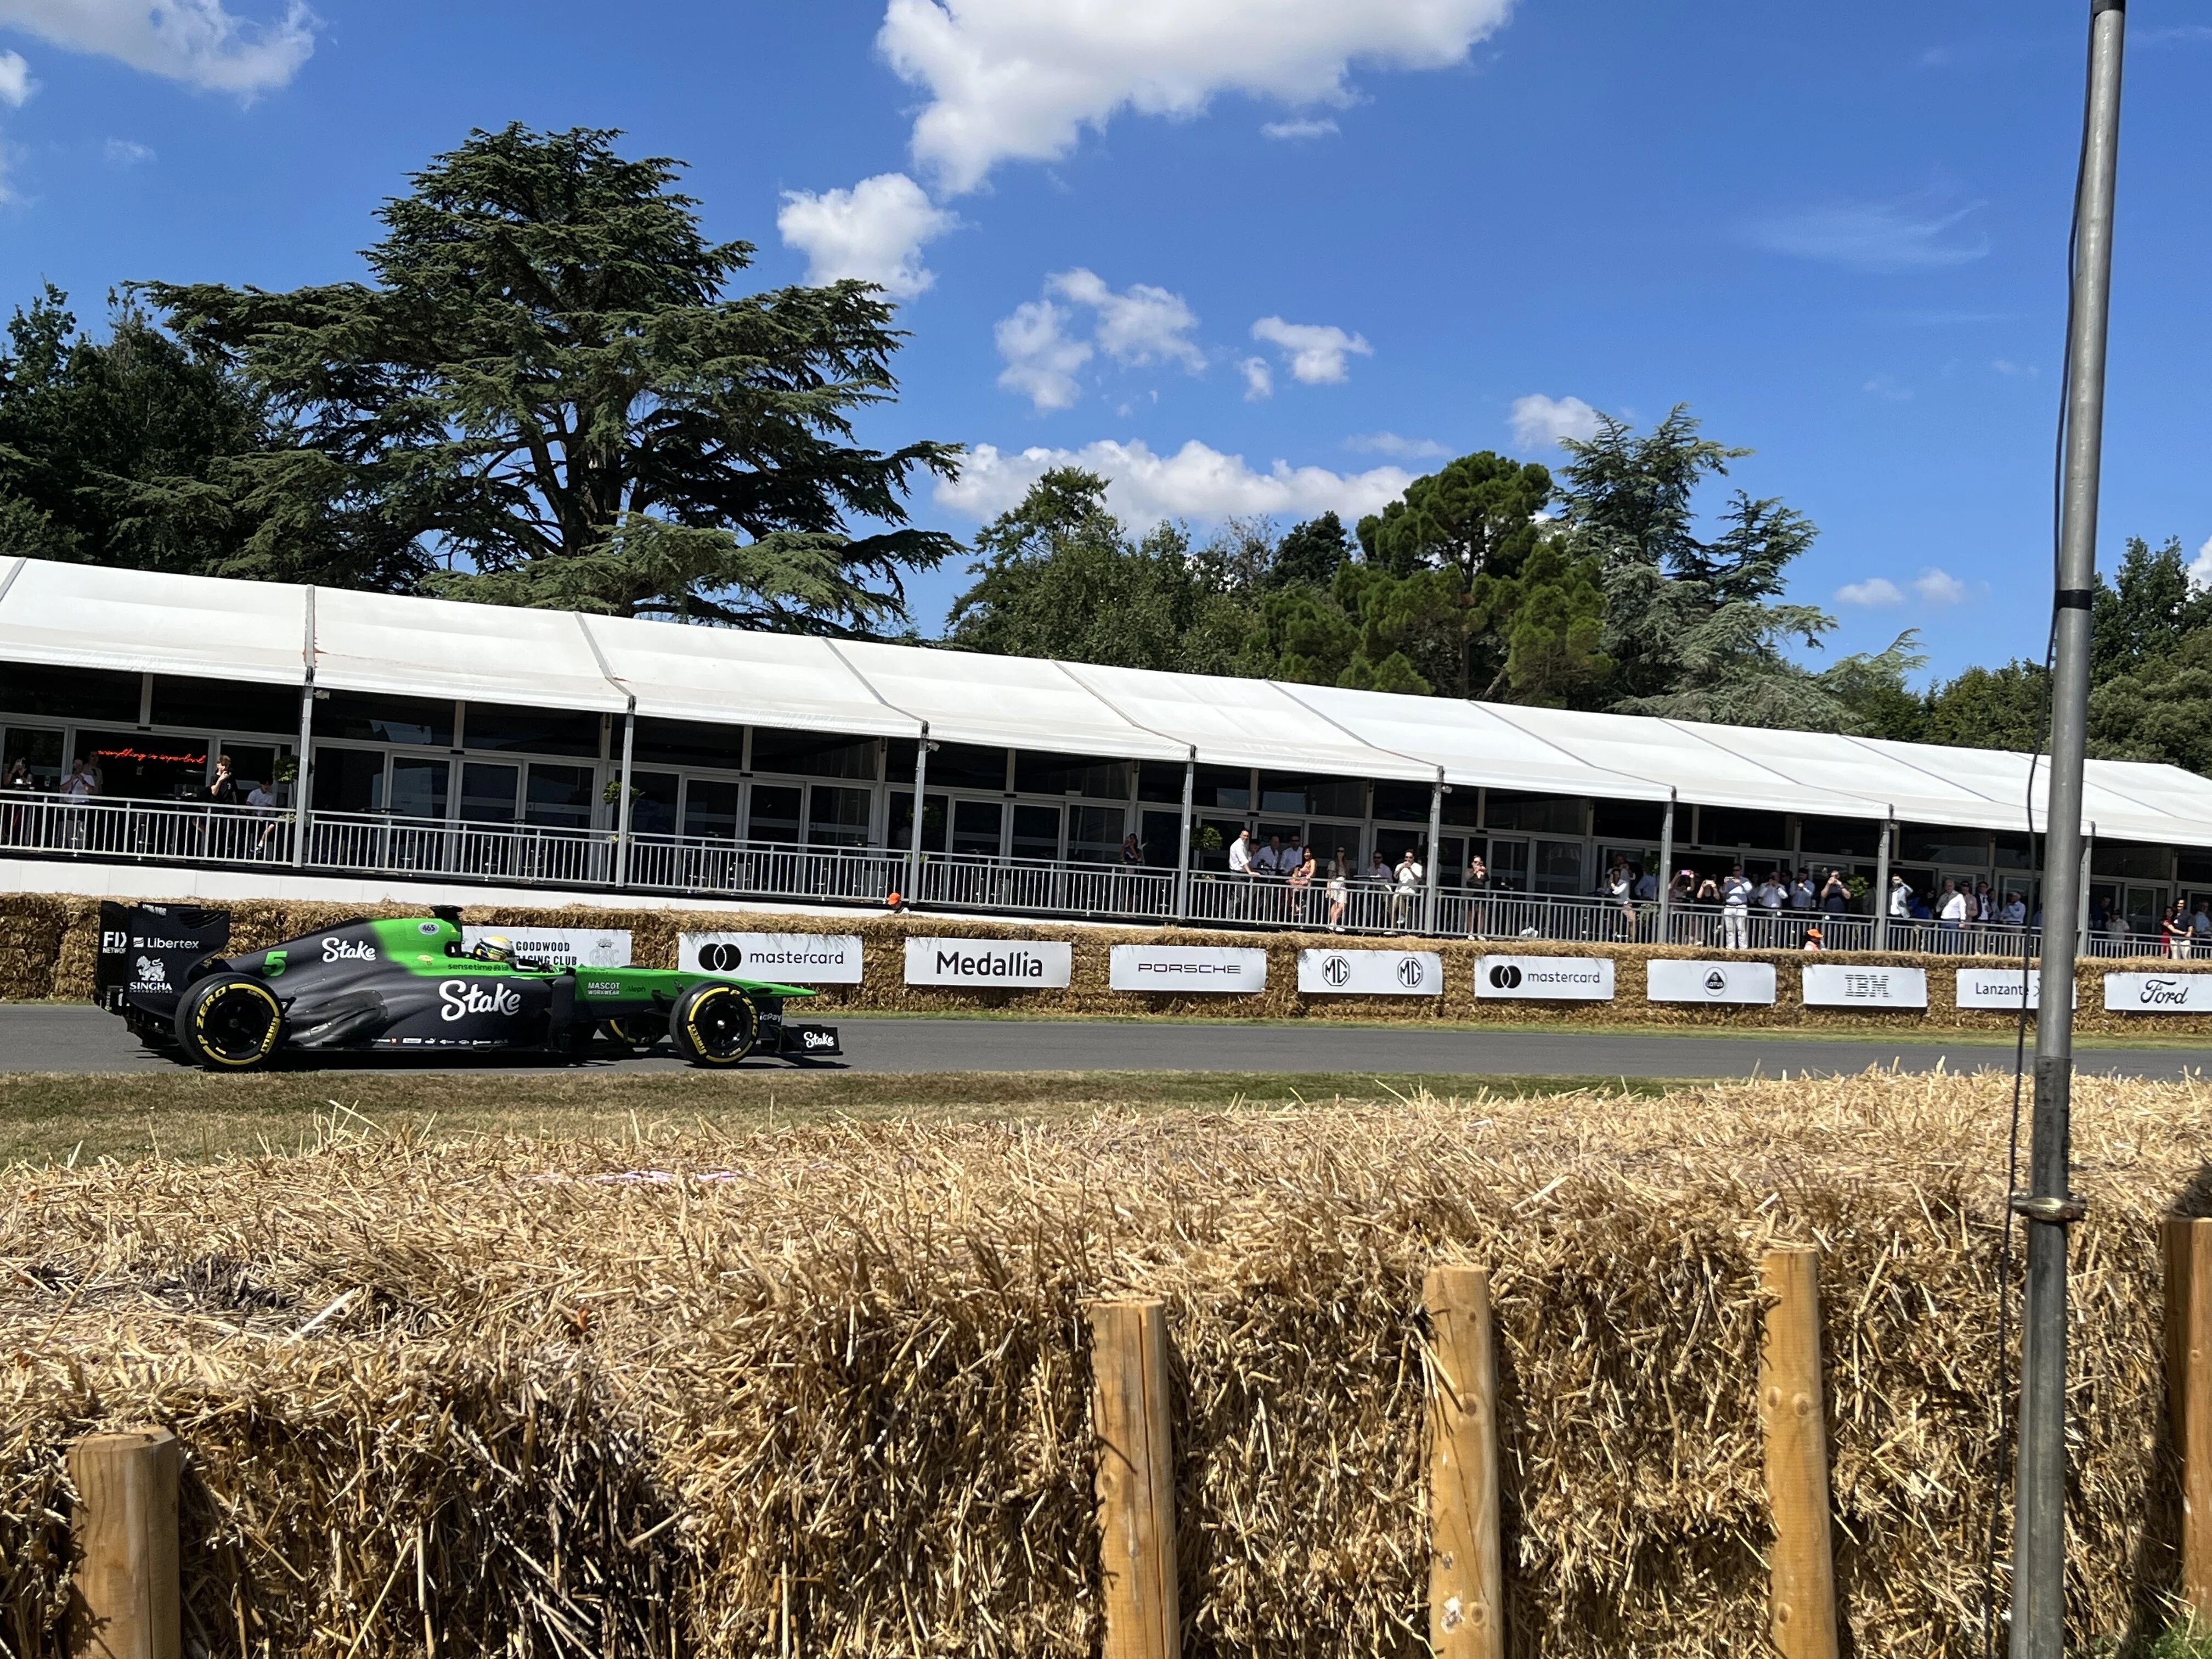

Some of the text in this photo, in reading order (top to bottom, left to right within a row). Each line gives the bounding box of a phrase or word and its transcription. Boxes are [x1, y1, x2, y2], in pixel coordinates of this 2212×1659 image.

[147, 937, 199, 949] Libertex
[321, 937, 376, 962] Stake
[516, 941, 570, 952] GOODWOOD
[262, 951, 288, 977] 5
[553, 955, 577, 966] CLUB
[749, 951, 844, 964] mastercard
[936, 950, 1042, 977] Medallia
[1138, 963, 1242, 974] PORSCHE
[1325, 958, 1347, 983] MG
[1400, 960, 1421, 985] MG
[1527, 971, 1600, 983] mastercard
[129, 982, 173, 990] SINGHA
[1844, 974, 1889, 997] IBM
[2140, 979, 2189, 1004] Ford
[196, 986, 227, 1030] ZERO
[439, 980, 521, 1021] Stake
[742, 996, 758, 1037] ZERO
[760, 1012, 782, 1022] icPay
[803, 1031, 834, 1048] Stake
